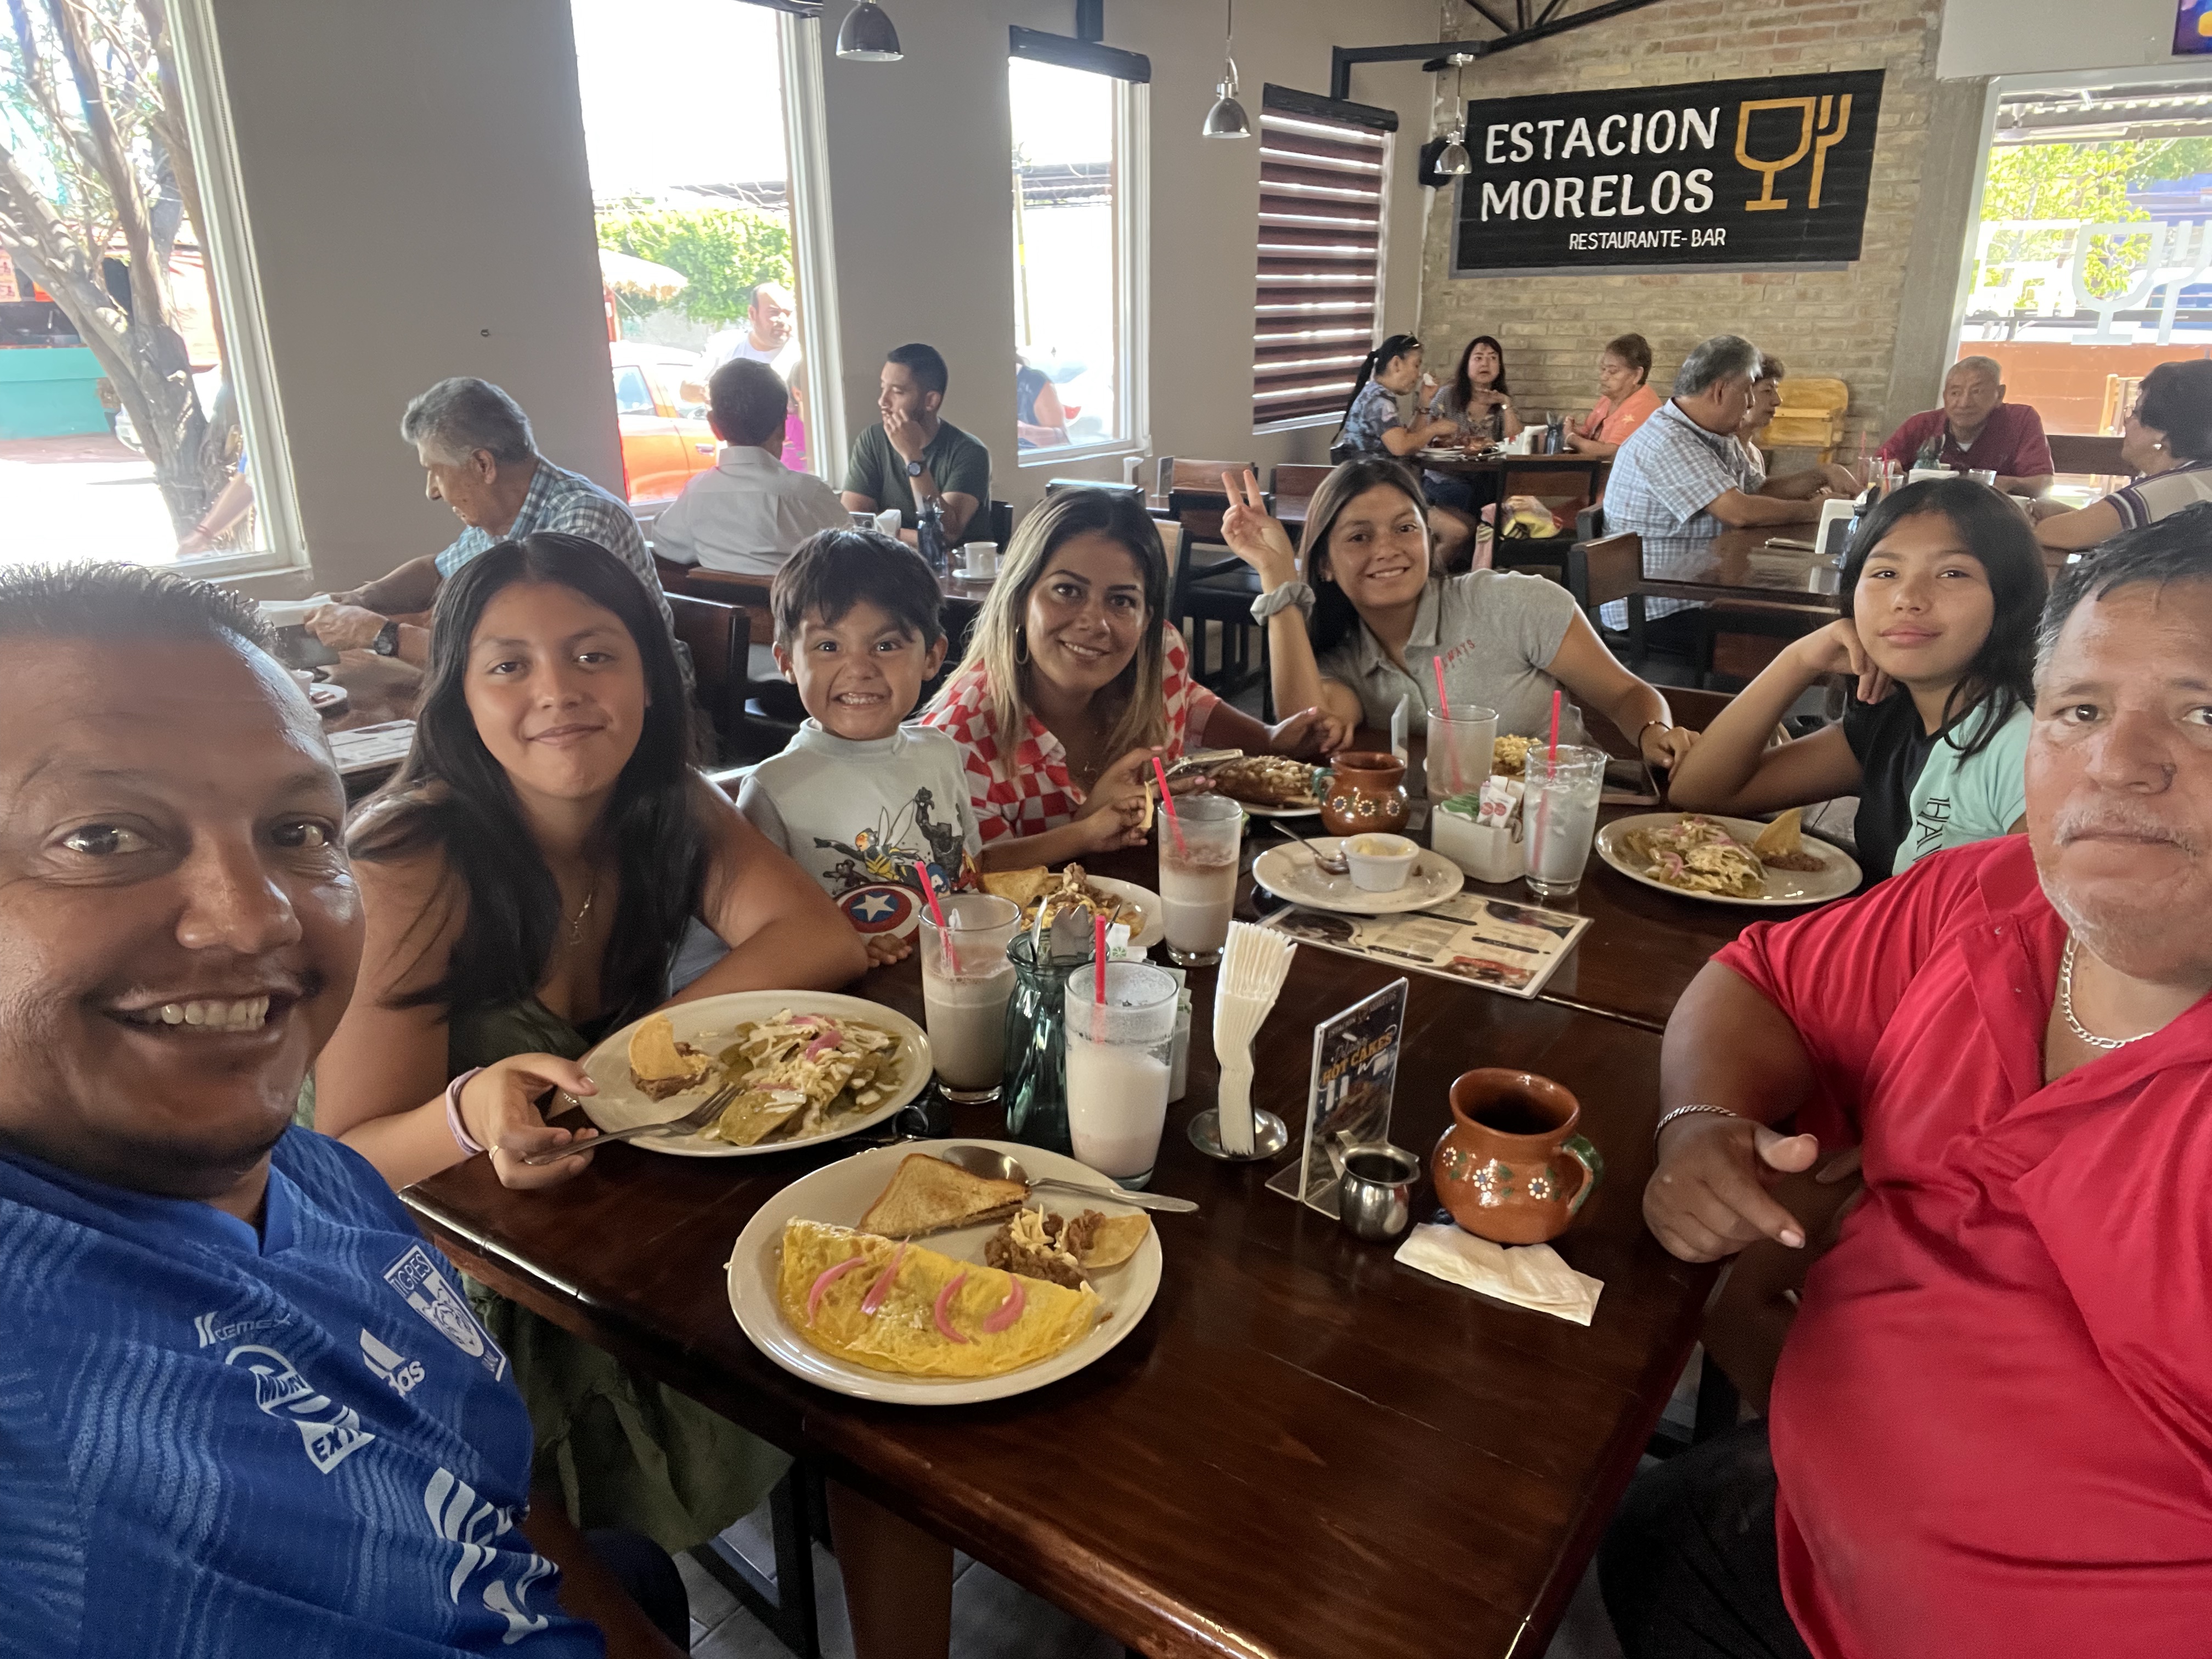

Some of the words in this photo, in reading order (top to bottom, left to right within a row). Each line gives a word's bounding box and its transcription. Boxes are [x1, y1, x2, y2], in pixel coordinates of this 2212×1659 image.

[1485, 107, 1720, 164] ESTACION
[1481, 168, 1714, 222] MORELOS
[1441, 639, 1476, 669] LWAYS
[1322, 1058, 1348, 1085] HOT
[1350, 1032, 1392, 1066] CAKES
[389, 1254, 431, 1297] TIGRES
